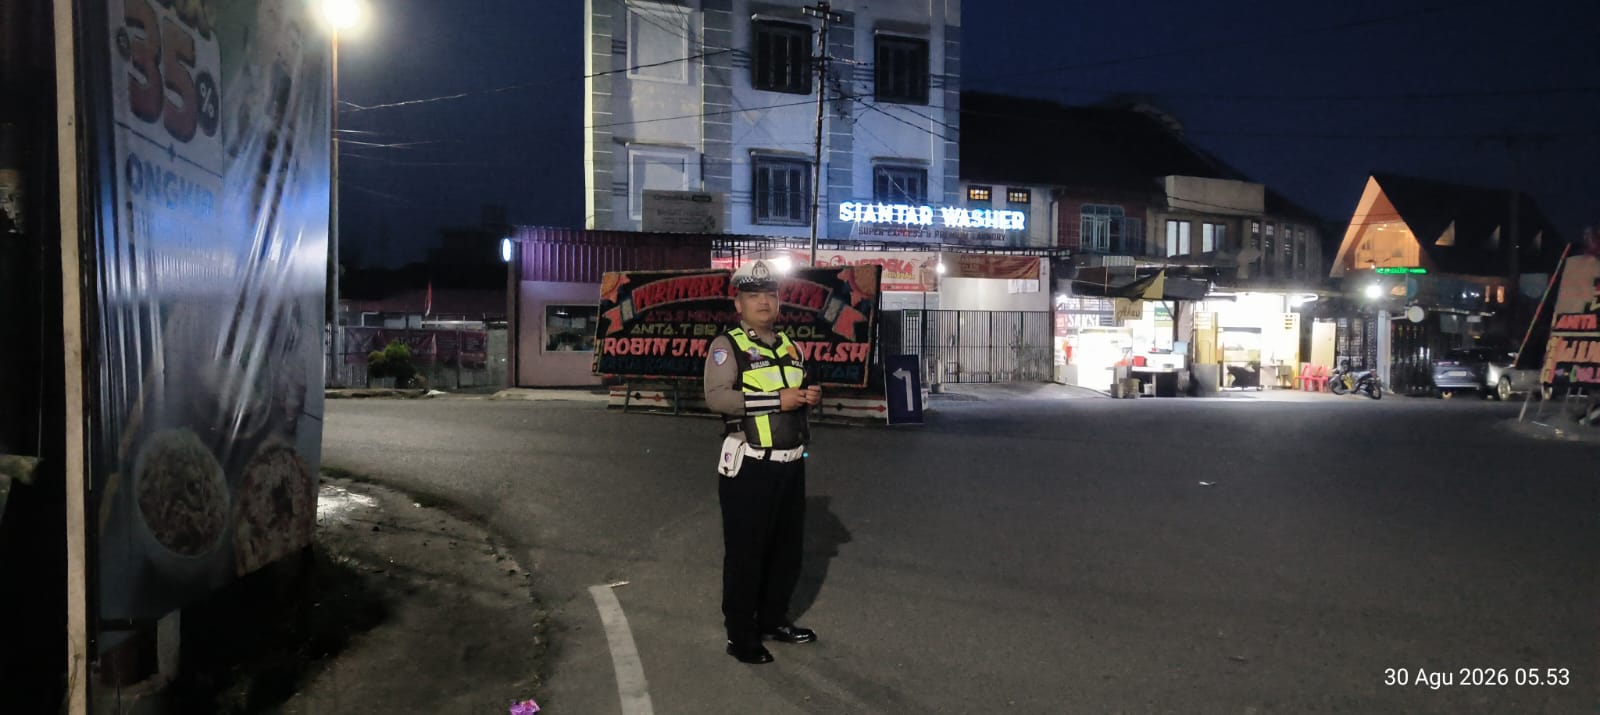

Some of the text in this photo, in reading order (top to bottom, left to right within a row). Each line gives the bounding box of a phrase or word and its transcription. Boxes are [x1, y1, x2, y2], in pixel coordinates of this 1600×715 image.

[839, 202, 1025, 230] SIANTAR WASHER
[603, 337, 670, 357] ROBIN
